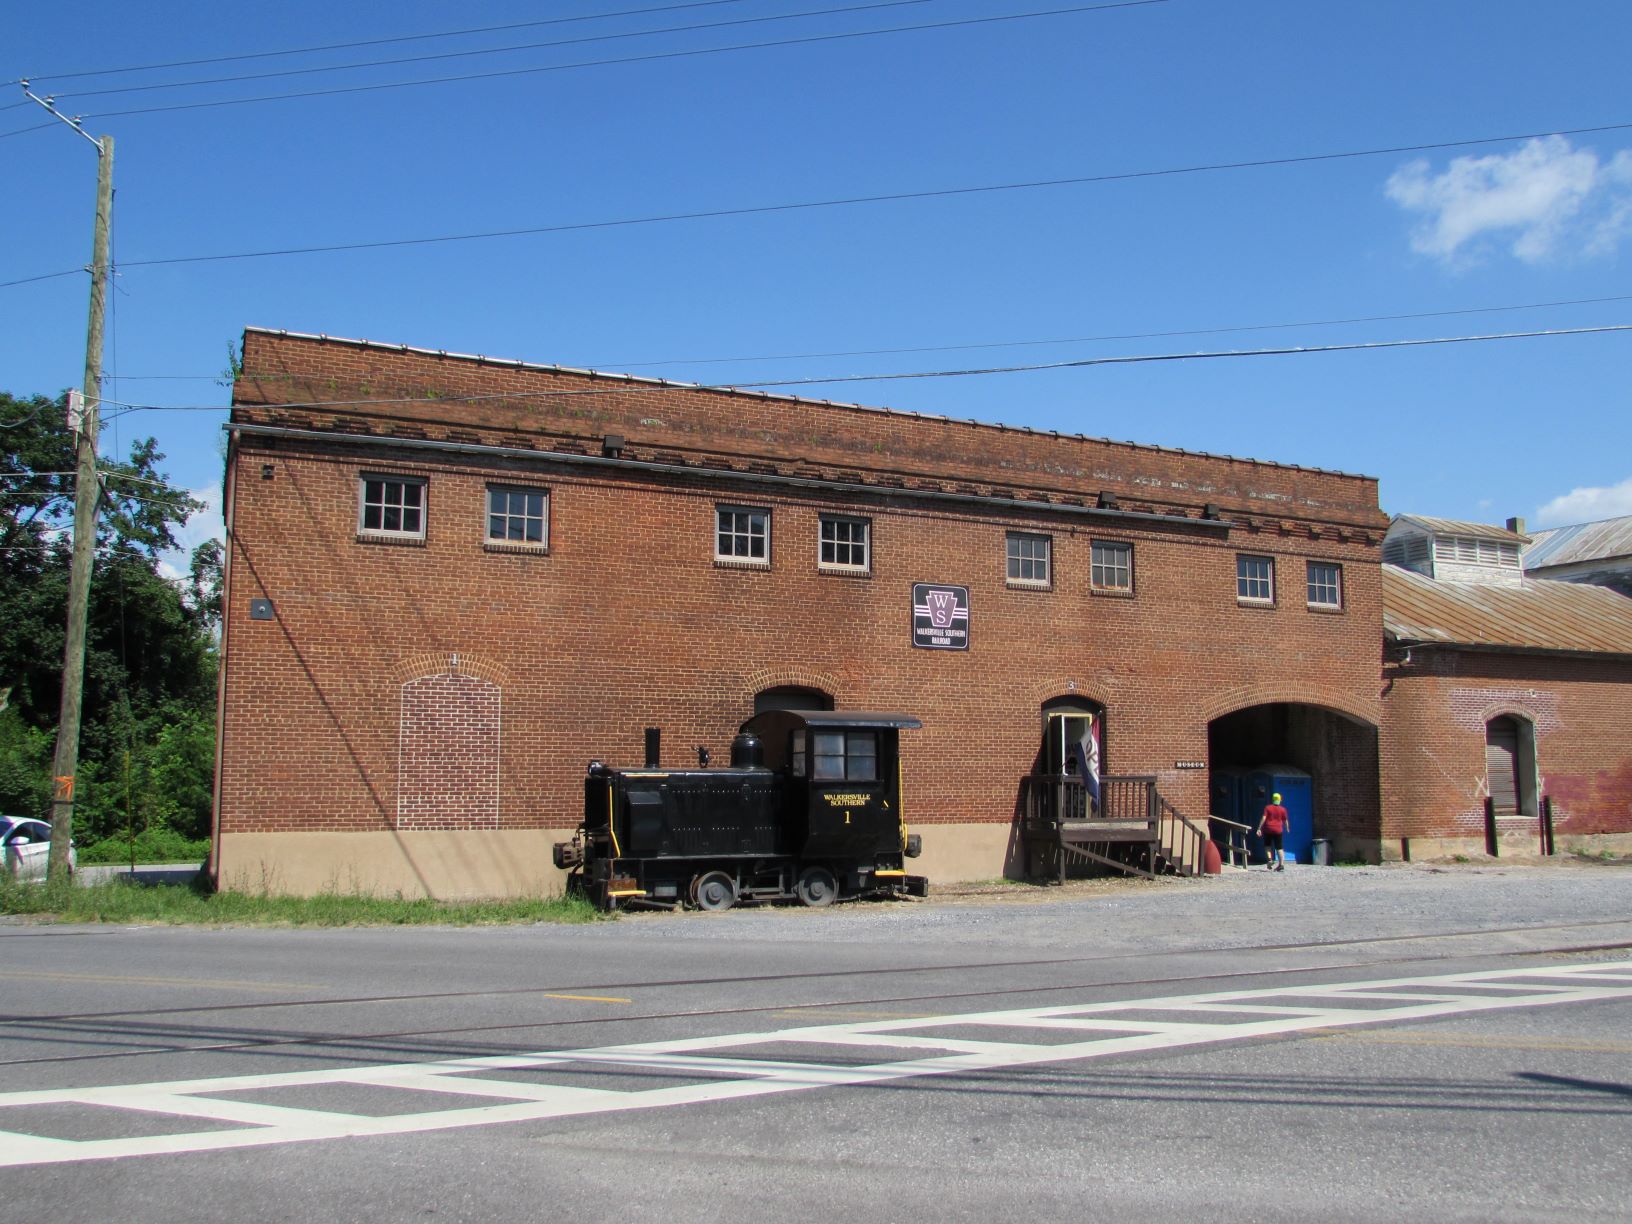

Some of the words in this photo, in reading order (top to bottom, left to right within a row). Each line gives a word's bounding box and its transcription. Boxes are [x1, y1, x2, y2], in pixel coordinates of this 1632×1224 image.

[934, 594, 948, 608] W
[936, 610, 946, 623] S
[945, 629, 965, 637] SOUTHERN
[931, 637, 951, 645] RAILROAD
[844, 810, 851, 824] 1
